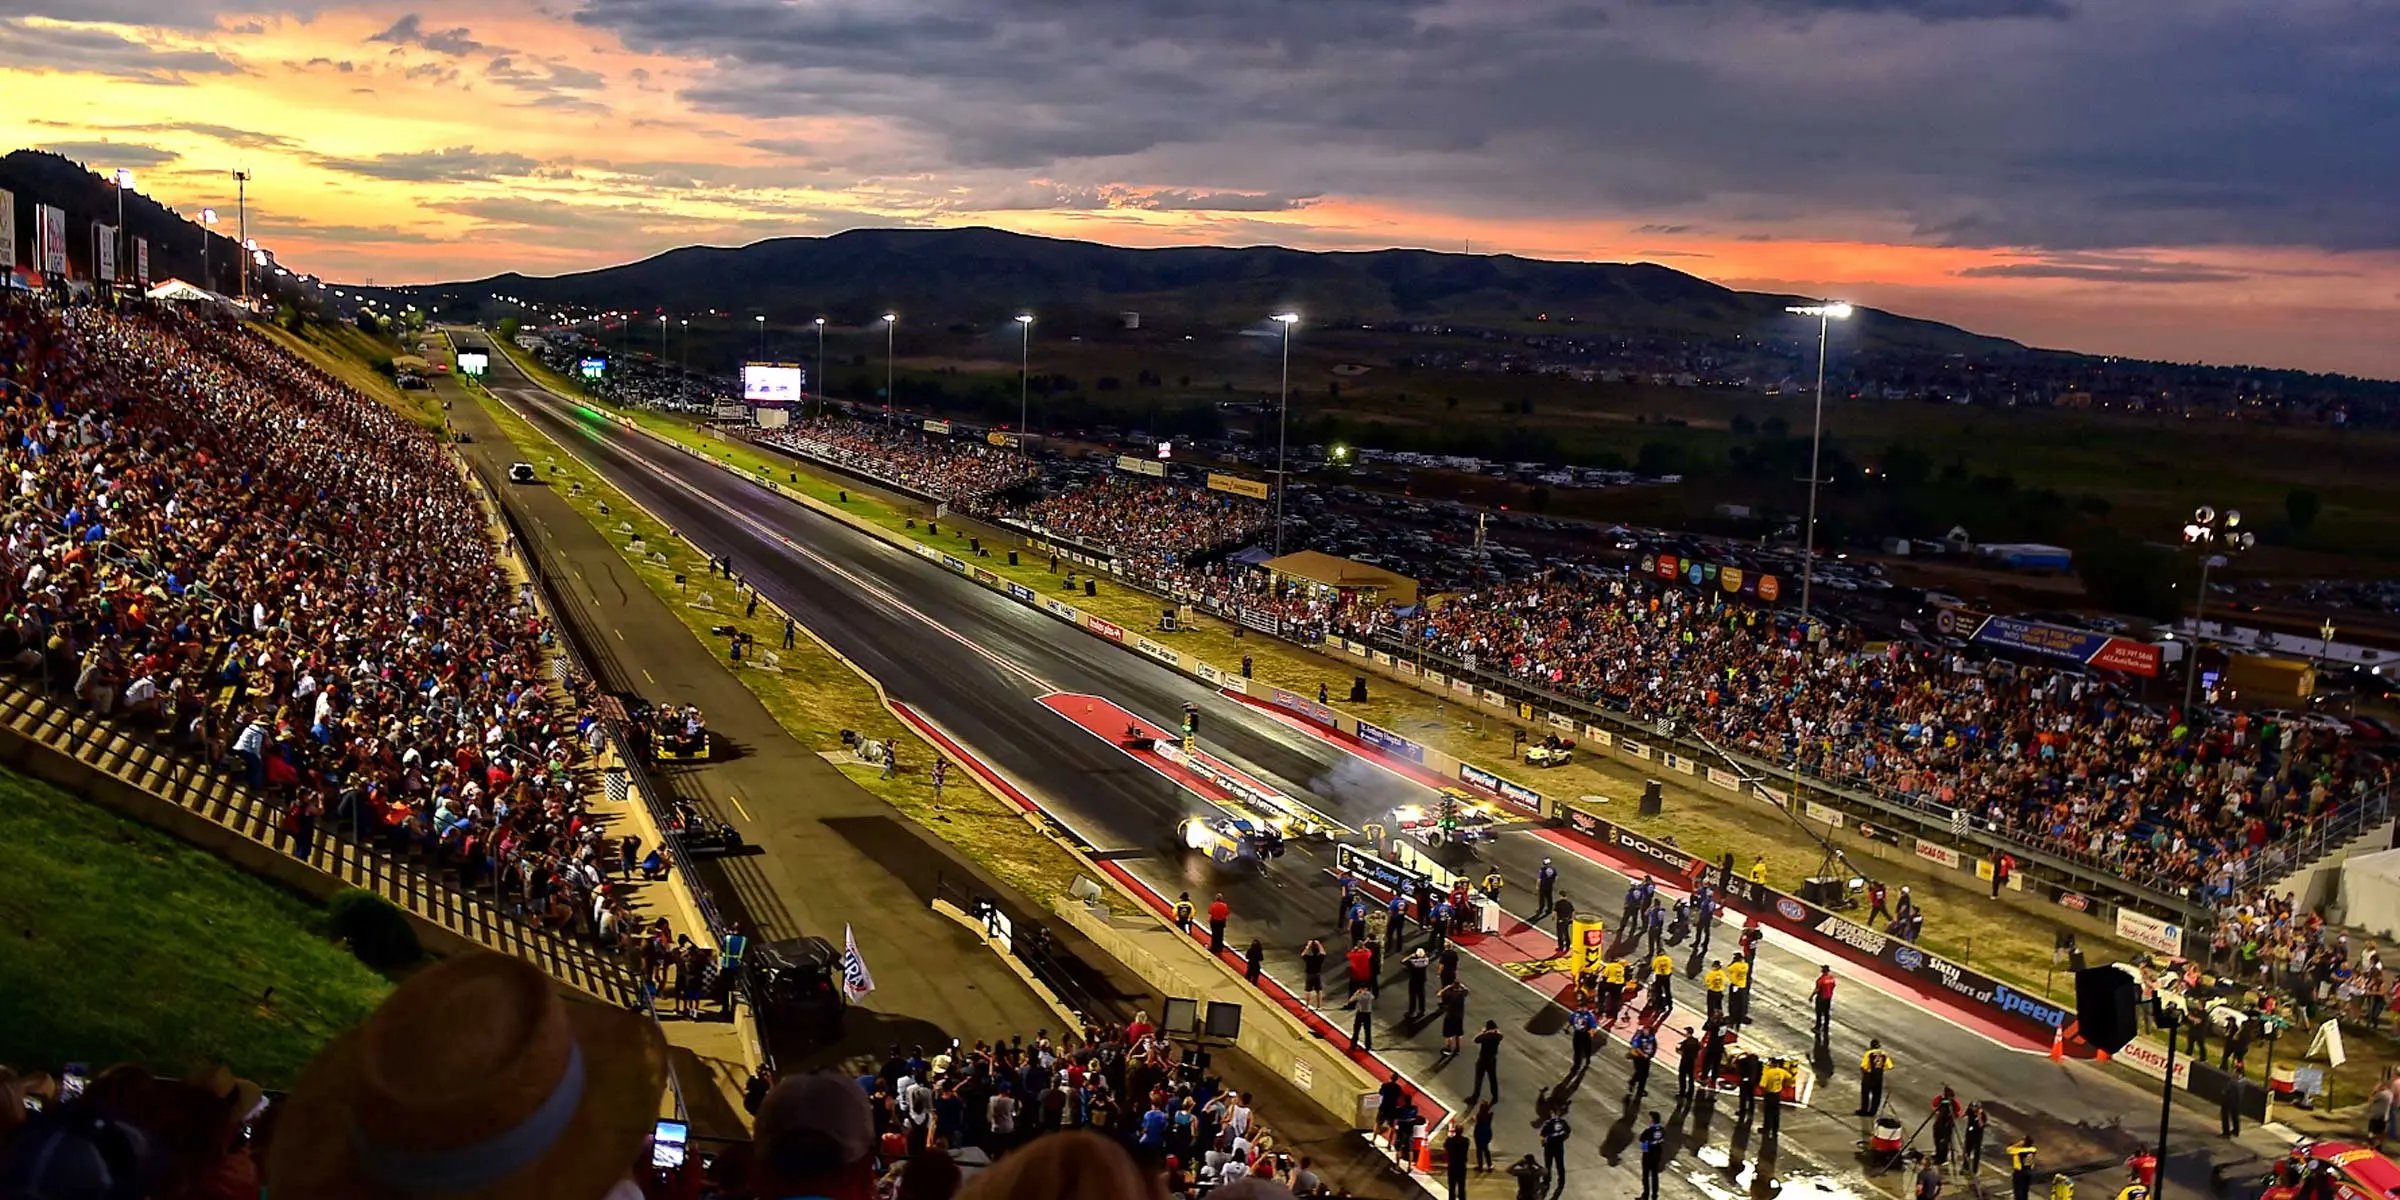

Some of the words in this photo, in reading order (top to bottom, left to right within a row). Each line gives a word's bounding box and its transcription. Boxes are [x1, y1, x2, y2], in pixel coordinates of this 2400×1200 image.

[1621, 835, 1691, 872] DODGE
[1835, 929, 1885, 956] SPEEDWAY
[1928, 957, 1961, 980] Sixty
[1942, 974, 1975, 997] Years
[1976, 990, 1993, 1004] of
[1993, 985, 2065, 1028] Speed
